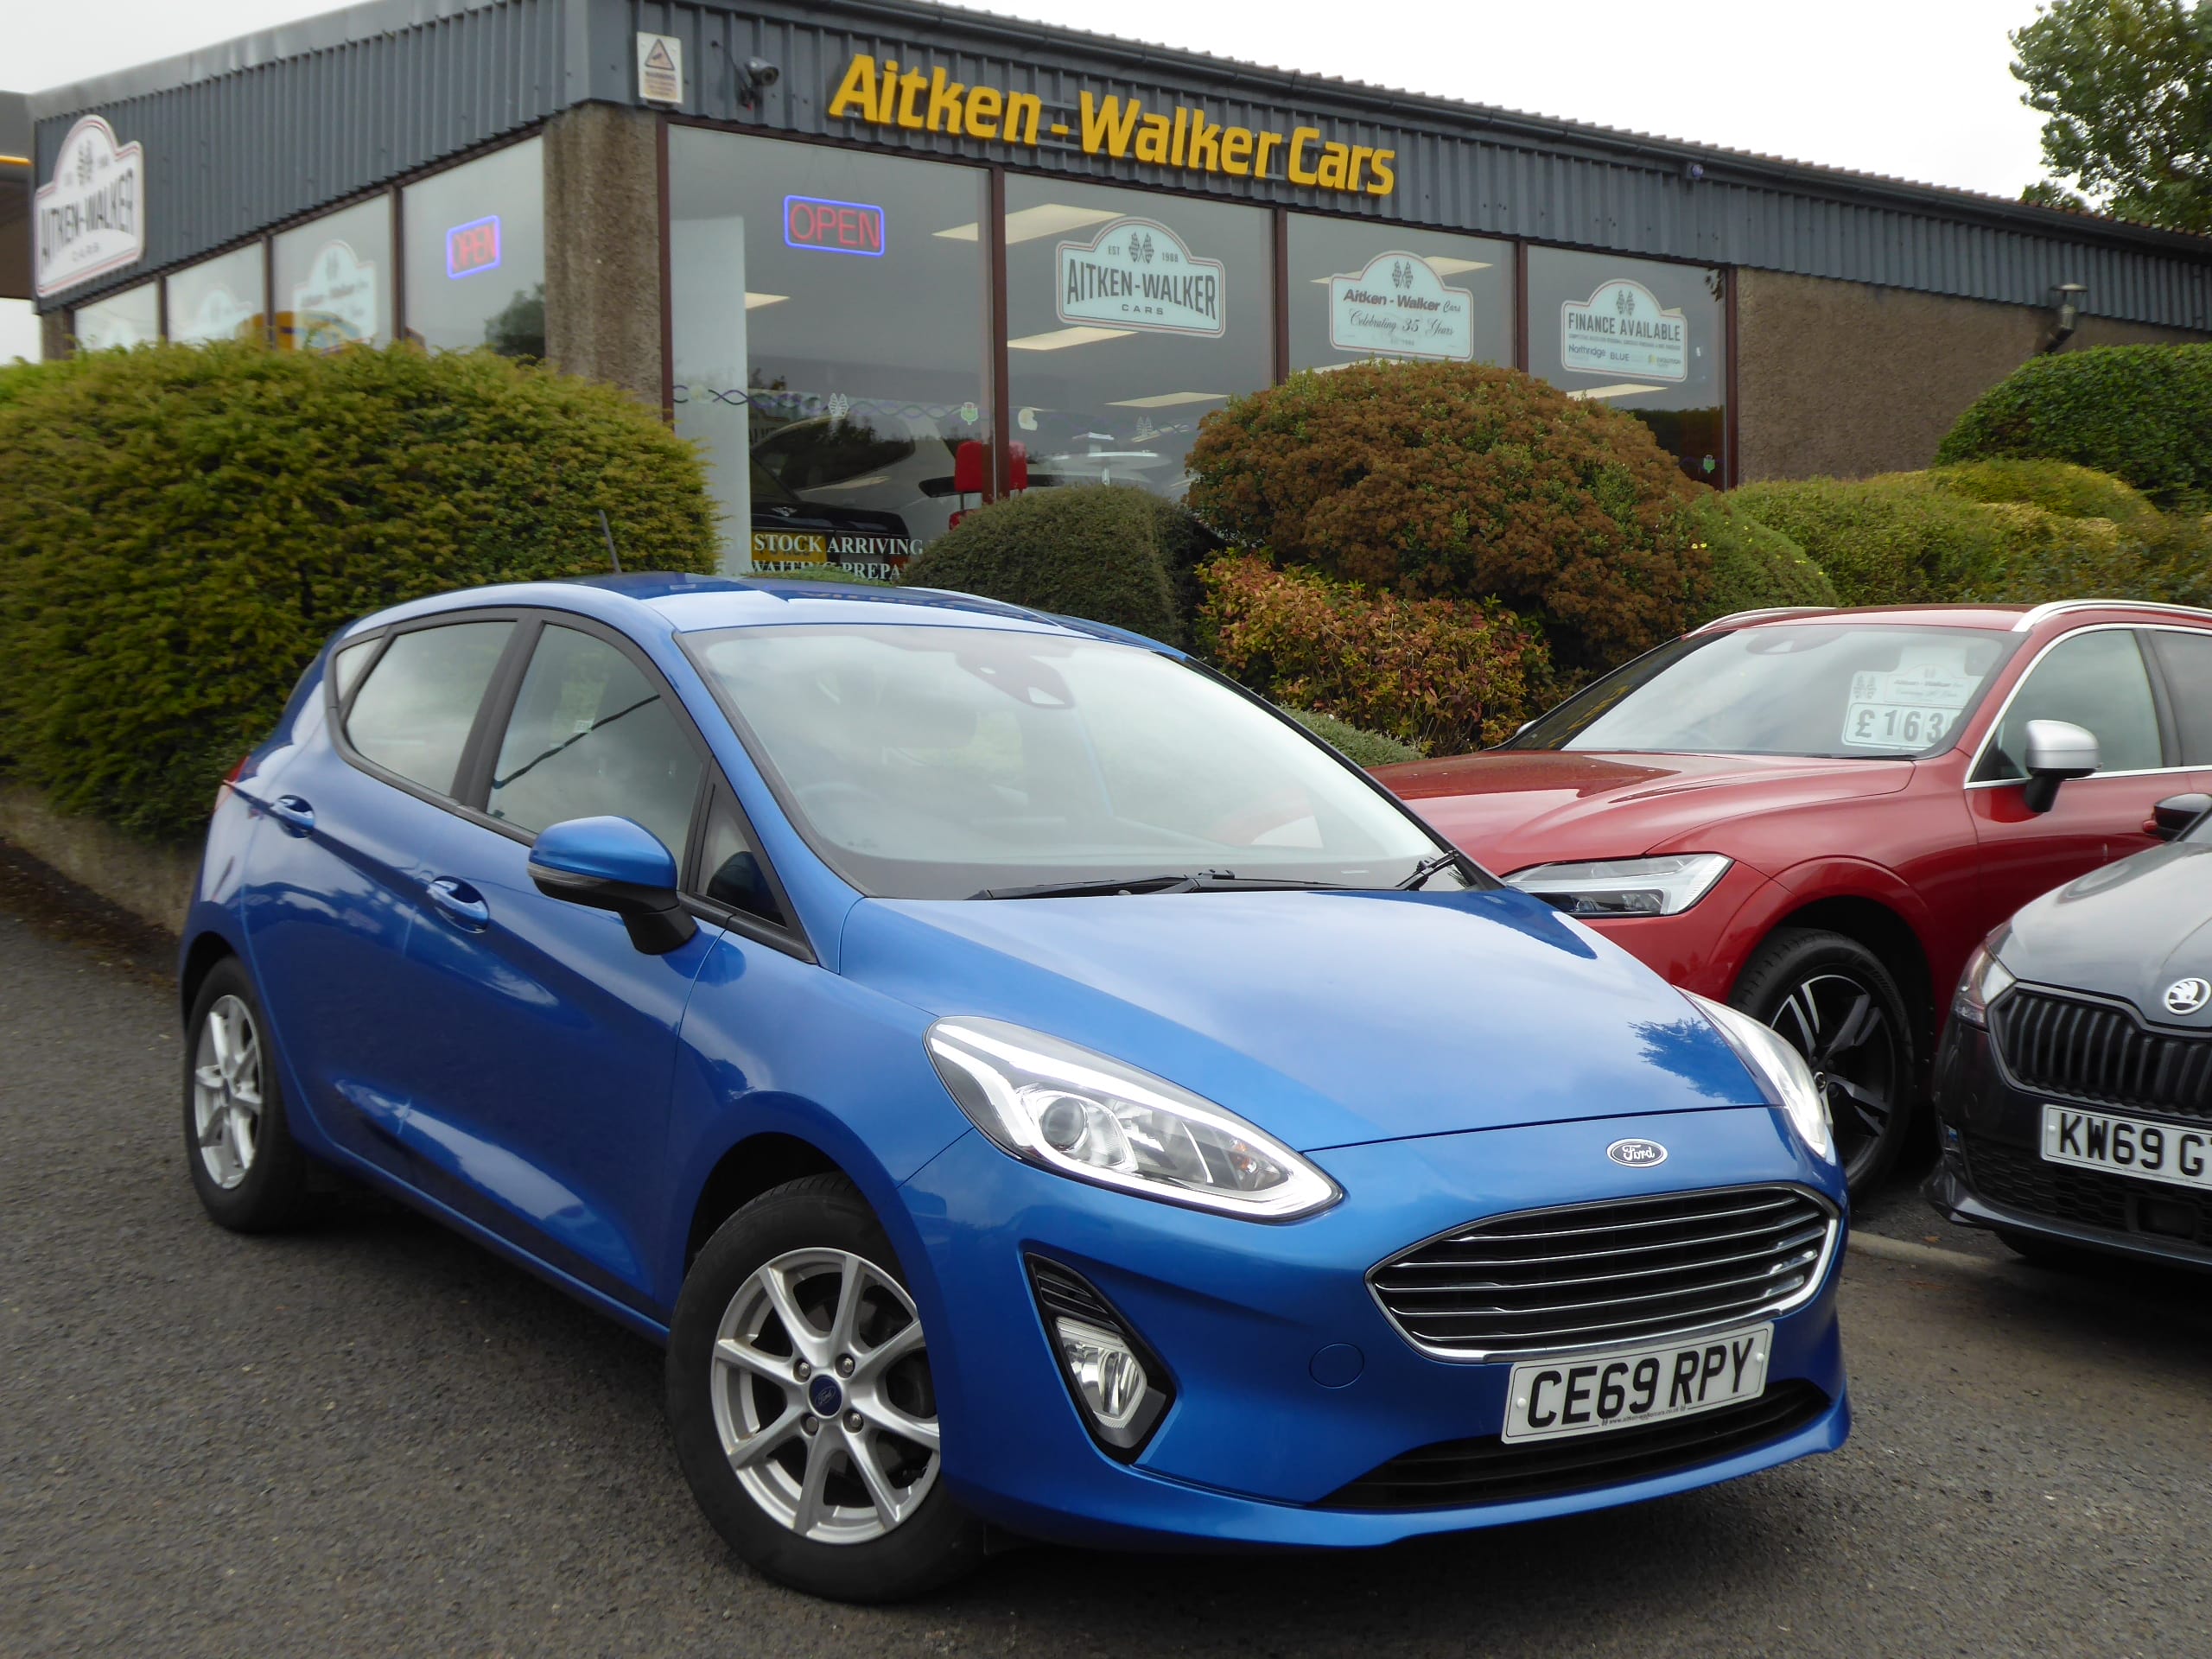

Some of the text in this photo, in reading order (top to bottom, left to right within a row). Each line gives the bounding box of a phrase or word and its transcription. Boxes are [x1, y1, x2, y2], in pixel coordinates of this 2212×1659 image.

[828, 53, 1042, 145] Aitken
[1079, 89, 1282, 179] Walker
[1287, 125, 1395, 196] Cars
[790, 203, 880, 251] OPEN
[1067, 258, 1217, 321] AITKEN-WALKER
[1343, 288, 1388, 306] Aitken
[1397, 294, 1441, 312] Walker
[1443, 300, 1462, 314] Cars
[1122, 303, 1164, 315] CARS
[1348, 308, 1454, 340] Celebrating 35 Years
[1568, 312, 1616, 334] FINANCE
[1619, 318, 1681, 342] AVAILABLE
[1610, 351, 1631, 362] BLUE
[753, 533, 823, 553] STOCK
[826, 537, 924, 556] ARRIVING
[751, 559, 902, 581] WAIT PREPA
[1855, 709, 1951, 743] £163
[1622, 1143, 1656, 1162] Ford
[2060, 1112, 2212, 1178] KW69 G
[1528, 1337, 1755, 1428] CE69 RPY
